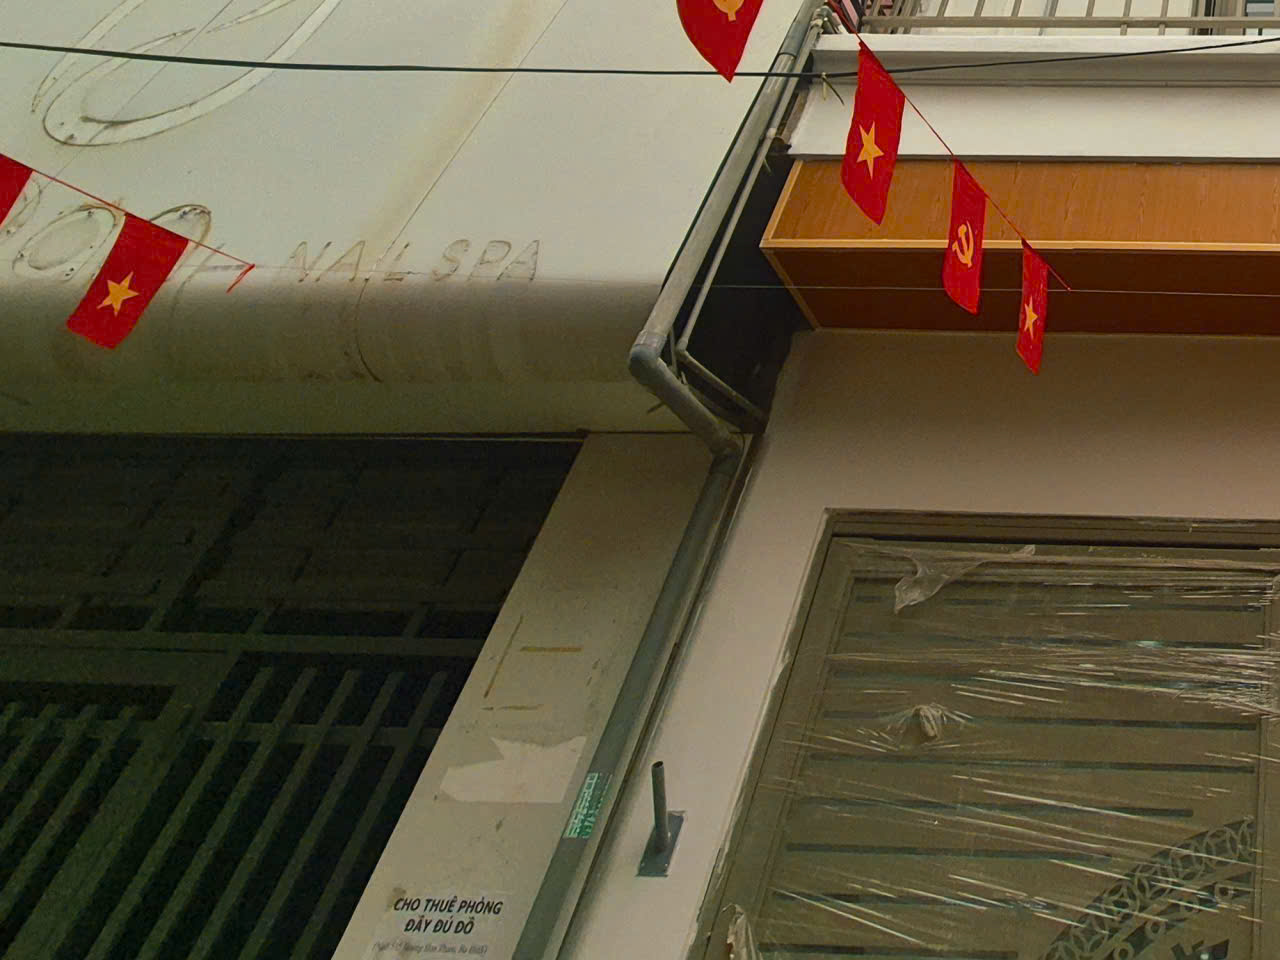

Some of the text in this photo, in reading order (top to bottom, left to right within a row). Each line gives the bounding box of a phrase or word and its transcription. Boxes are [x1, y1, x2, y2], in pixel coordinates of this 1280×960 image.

[432, 239, 543, 282] SPA
[393, 898, 421, 912] CHO
[423, 895, 458, 913] THUÊ
